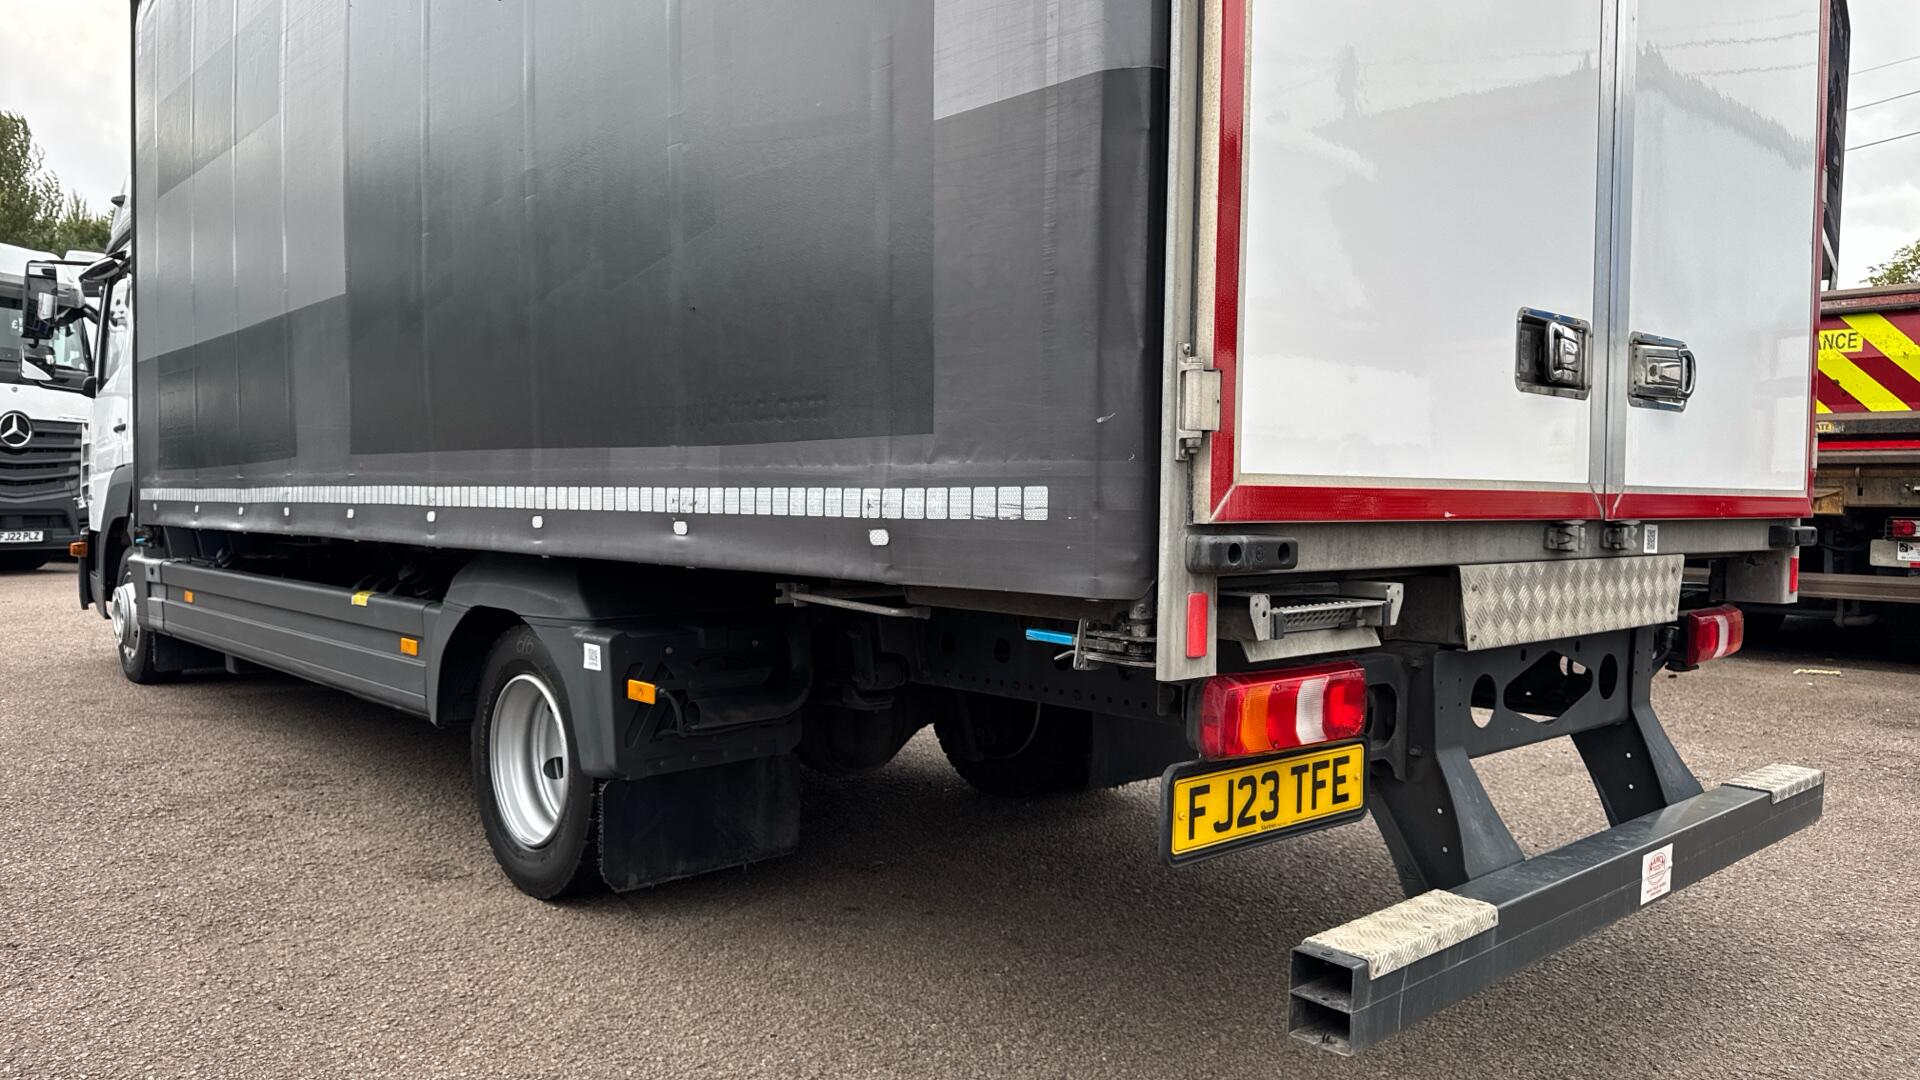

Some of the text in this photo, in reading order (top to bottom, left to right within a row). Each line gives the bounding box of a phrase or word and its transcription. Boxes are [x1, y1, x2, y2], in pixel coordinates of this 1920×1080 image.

[23, 532, 39, 541] PLZ
[1188, 755, 1350, 840] FJ23 TFE
